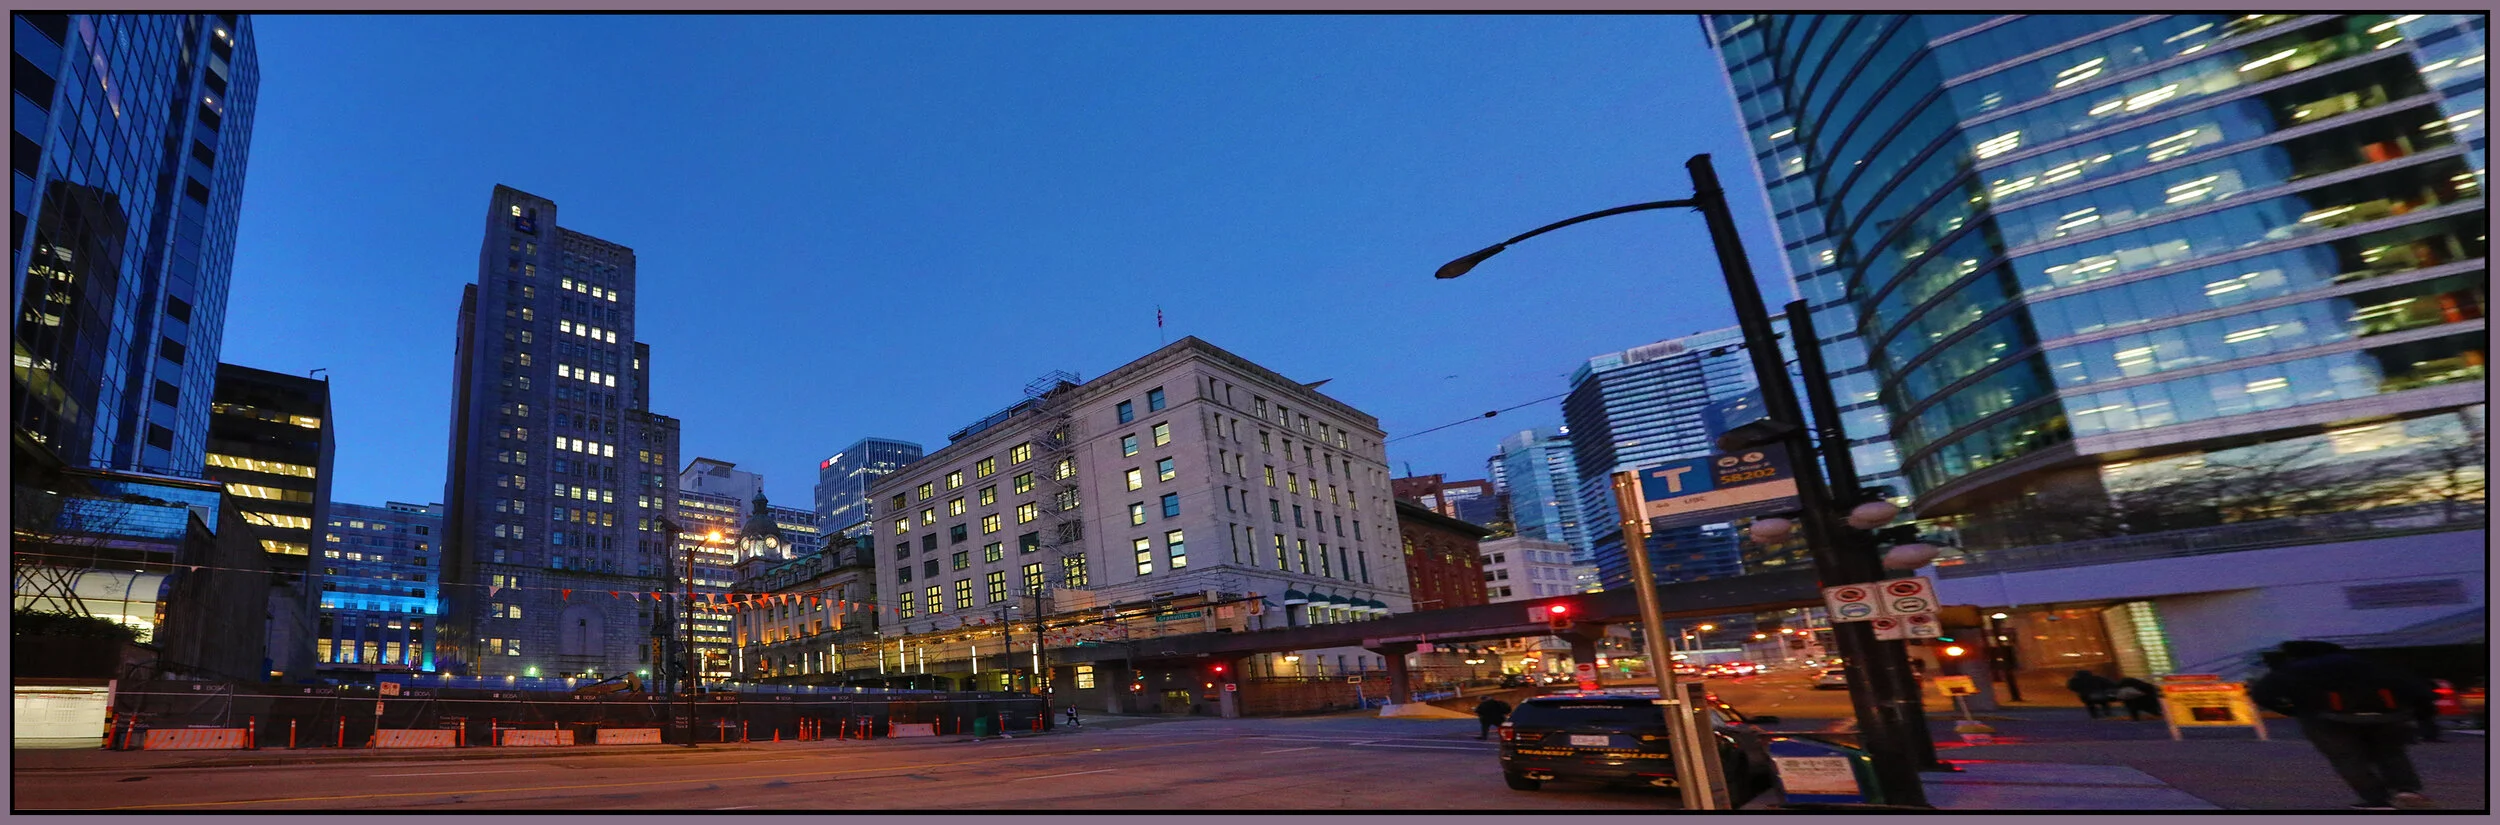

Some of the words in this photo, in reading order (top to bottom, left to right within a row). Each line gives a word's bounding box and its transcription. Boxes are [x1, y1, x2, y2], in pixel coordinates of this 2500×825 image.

[1652, 466, 1692, 493] T
[1720, 467, 1776, 484] 58202
[1159, 613, 1188, 621] Granville
[1517, 749, 1575, 757] TRANSIT
